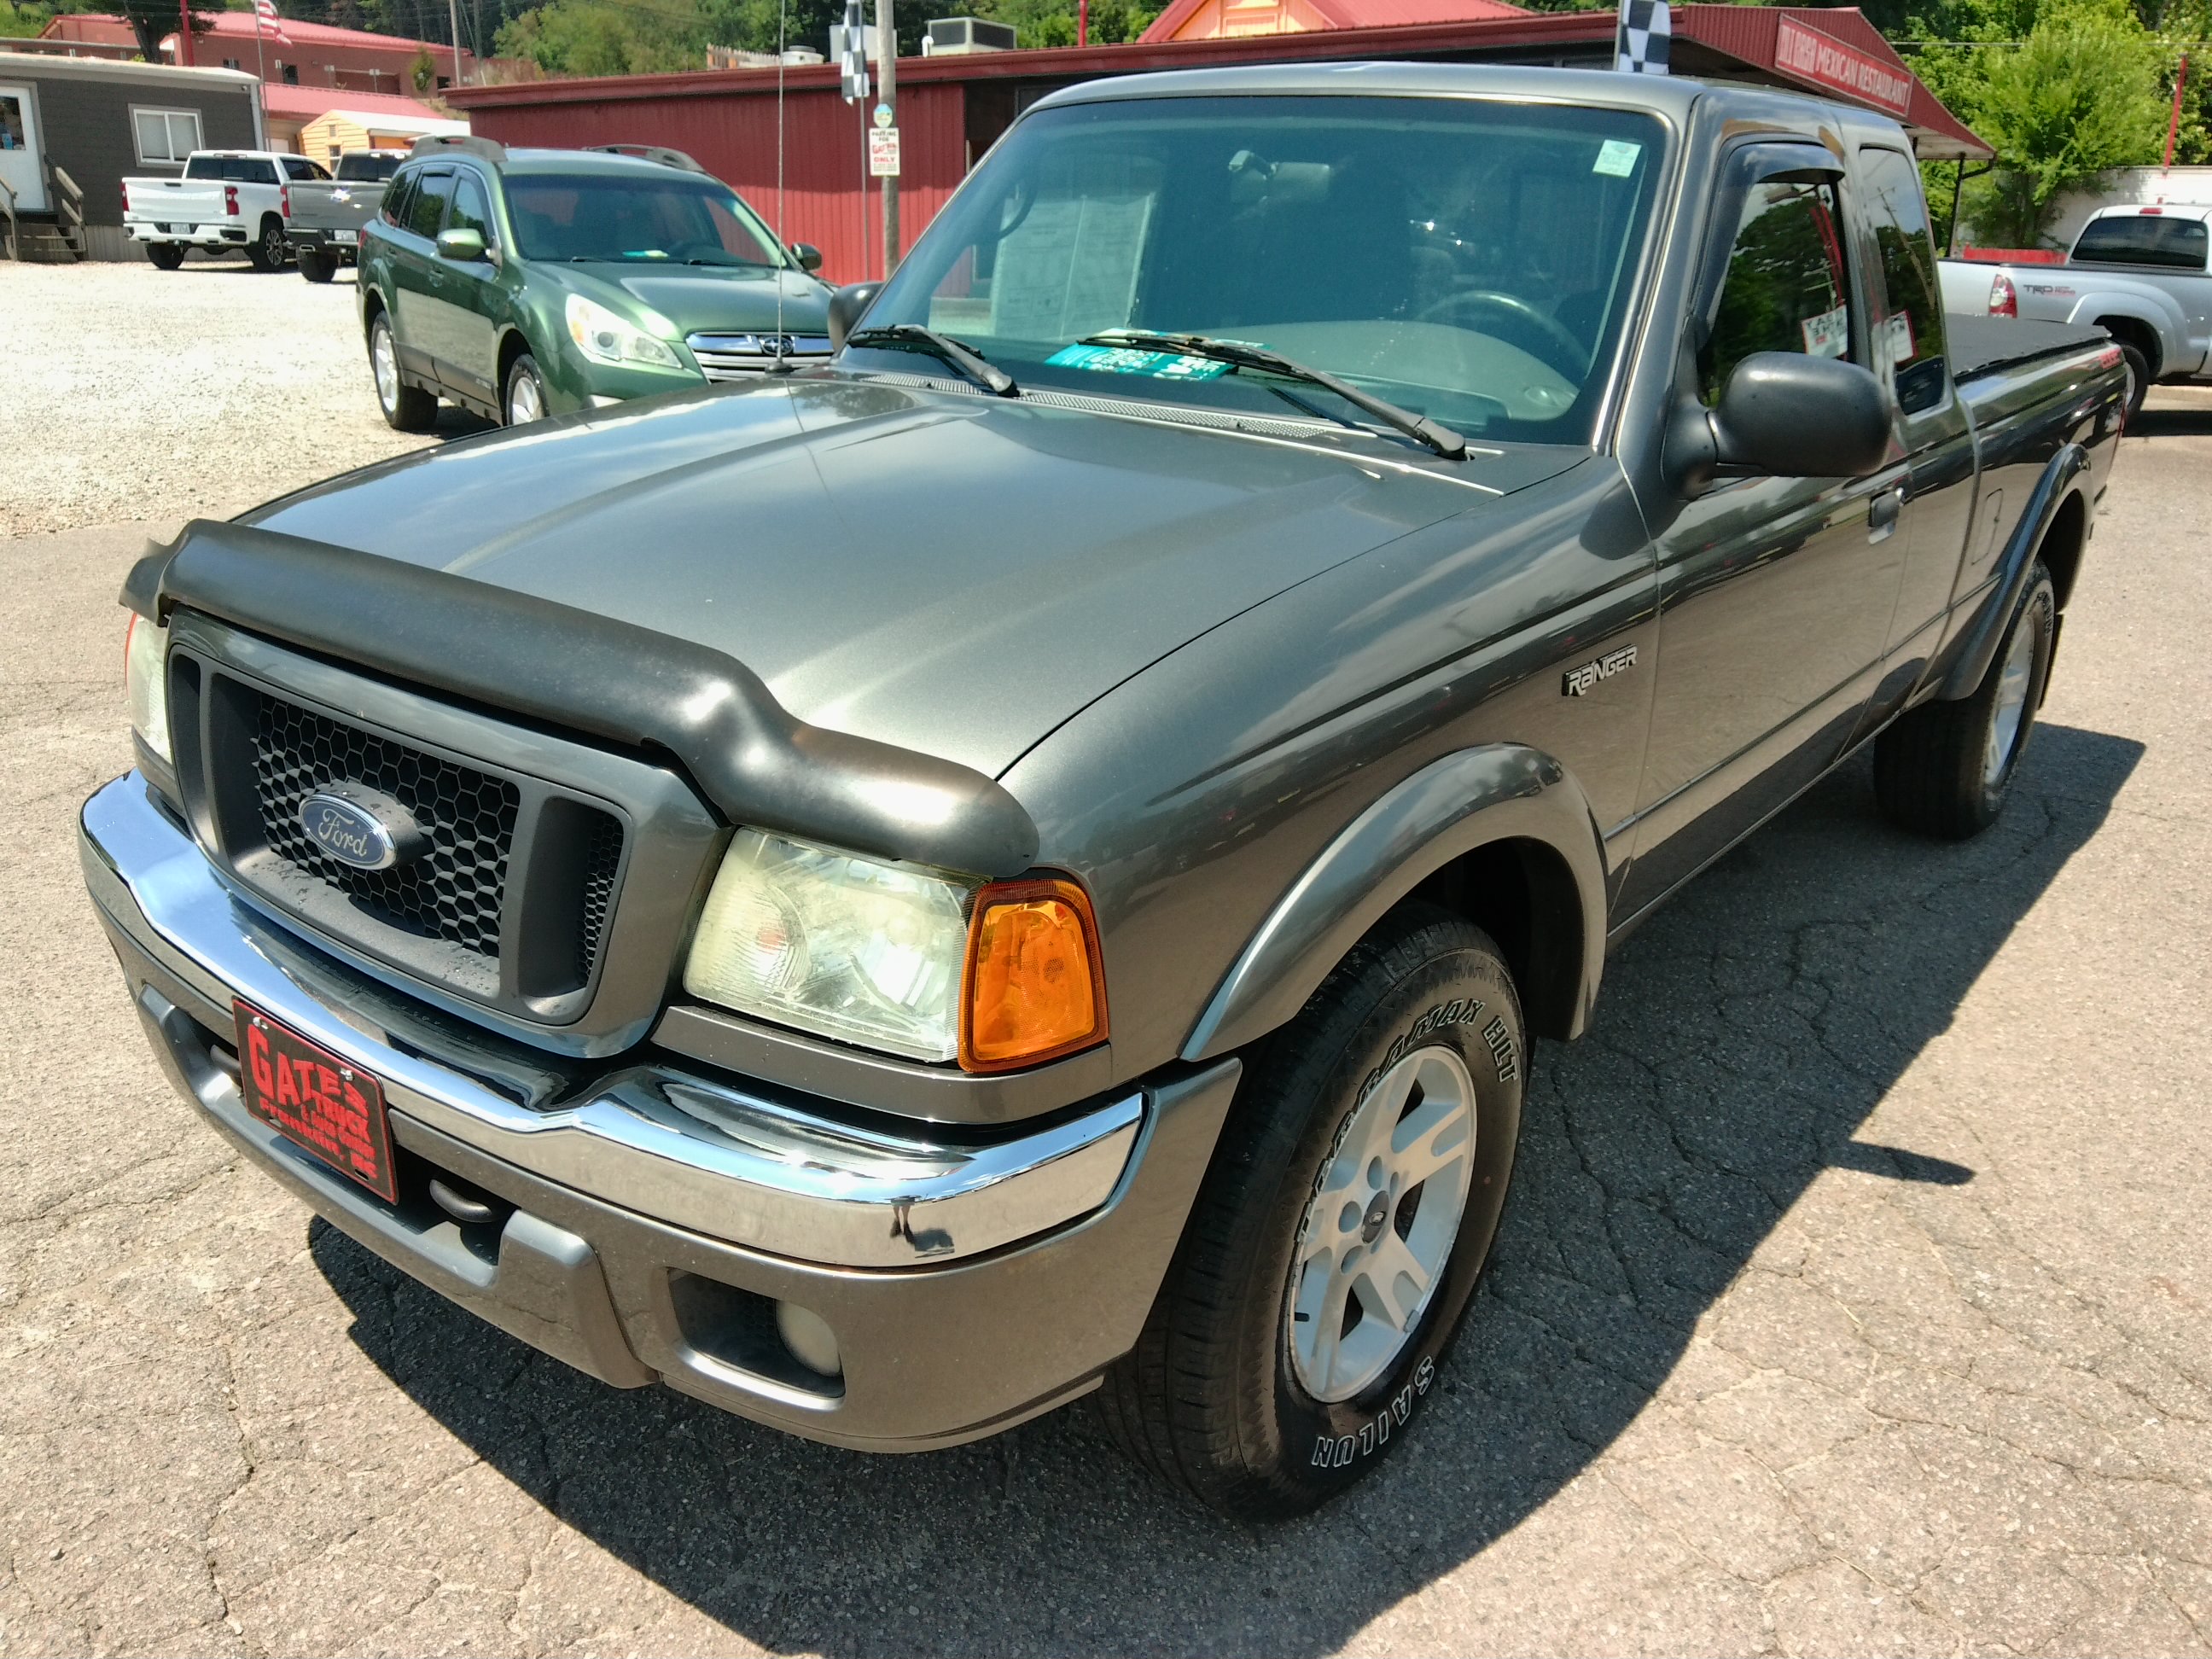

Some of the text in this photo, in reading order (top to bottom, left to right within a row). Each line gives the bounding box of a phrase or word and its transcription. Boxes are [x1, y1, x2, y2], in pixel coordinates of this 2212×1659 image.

[1815, 44, 1860, 86] MEXICAN
[1857, 64, 1910, 107] RESTAURANT
[2023, 285, 2053, 294] TRD
[1565, 644, 1638, 696] RANGER
[317, 808, 368, 858] Ford
[248, 1024, 370, 1118] GATES
[1483, 1016, 1518, 1083] HLT
[311, 1089, 373, 1144] TRUCK
[1311, 1355, 1435, 1469] SAILUN
